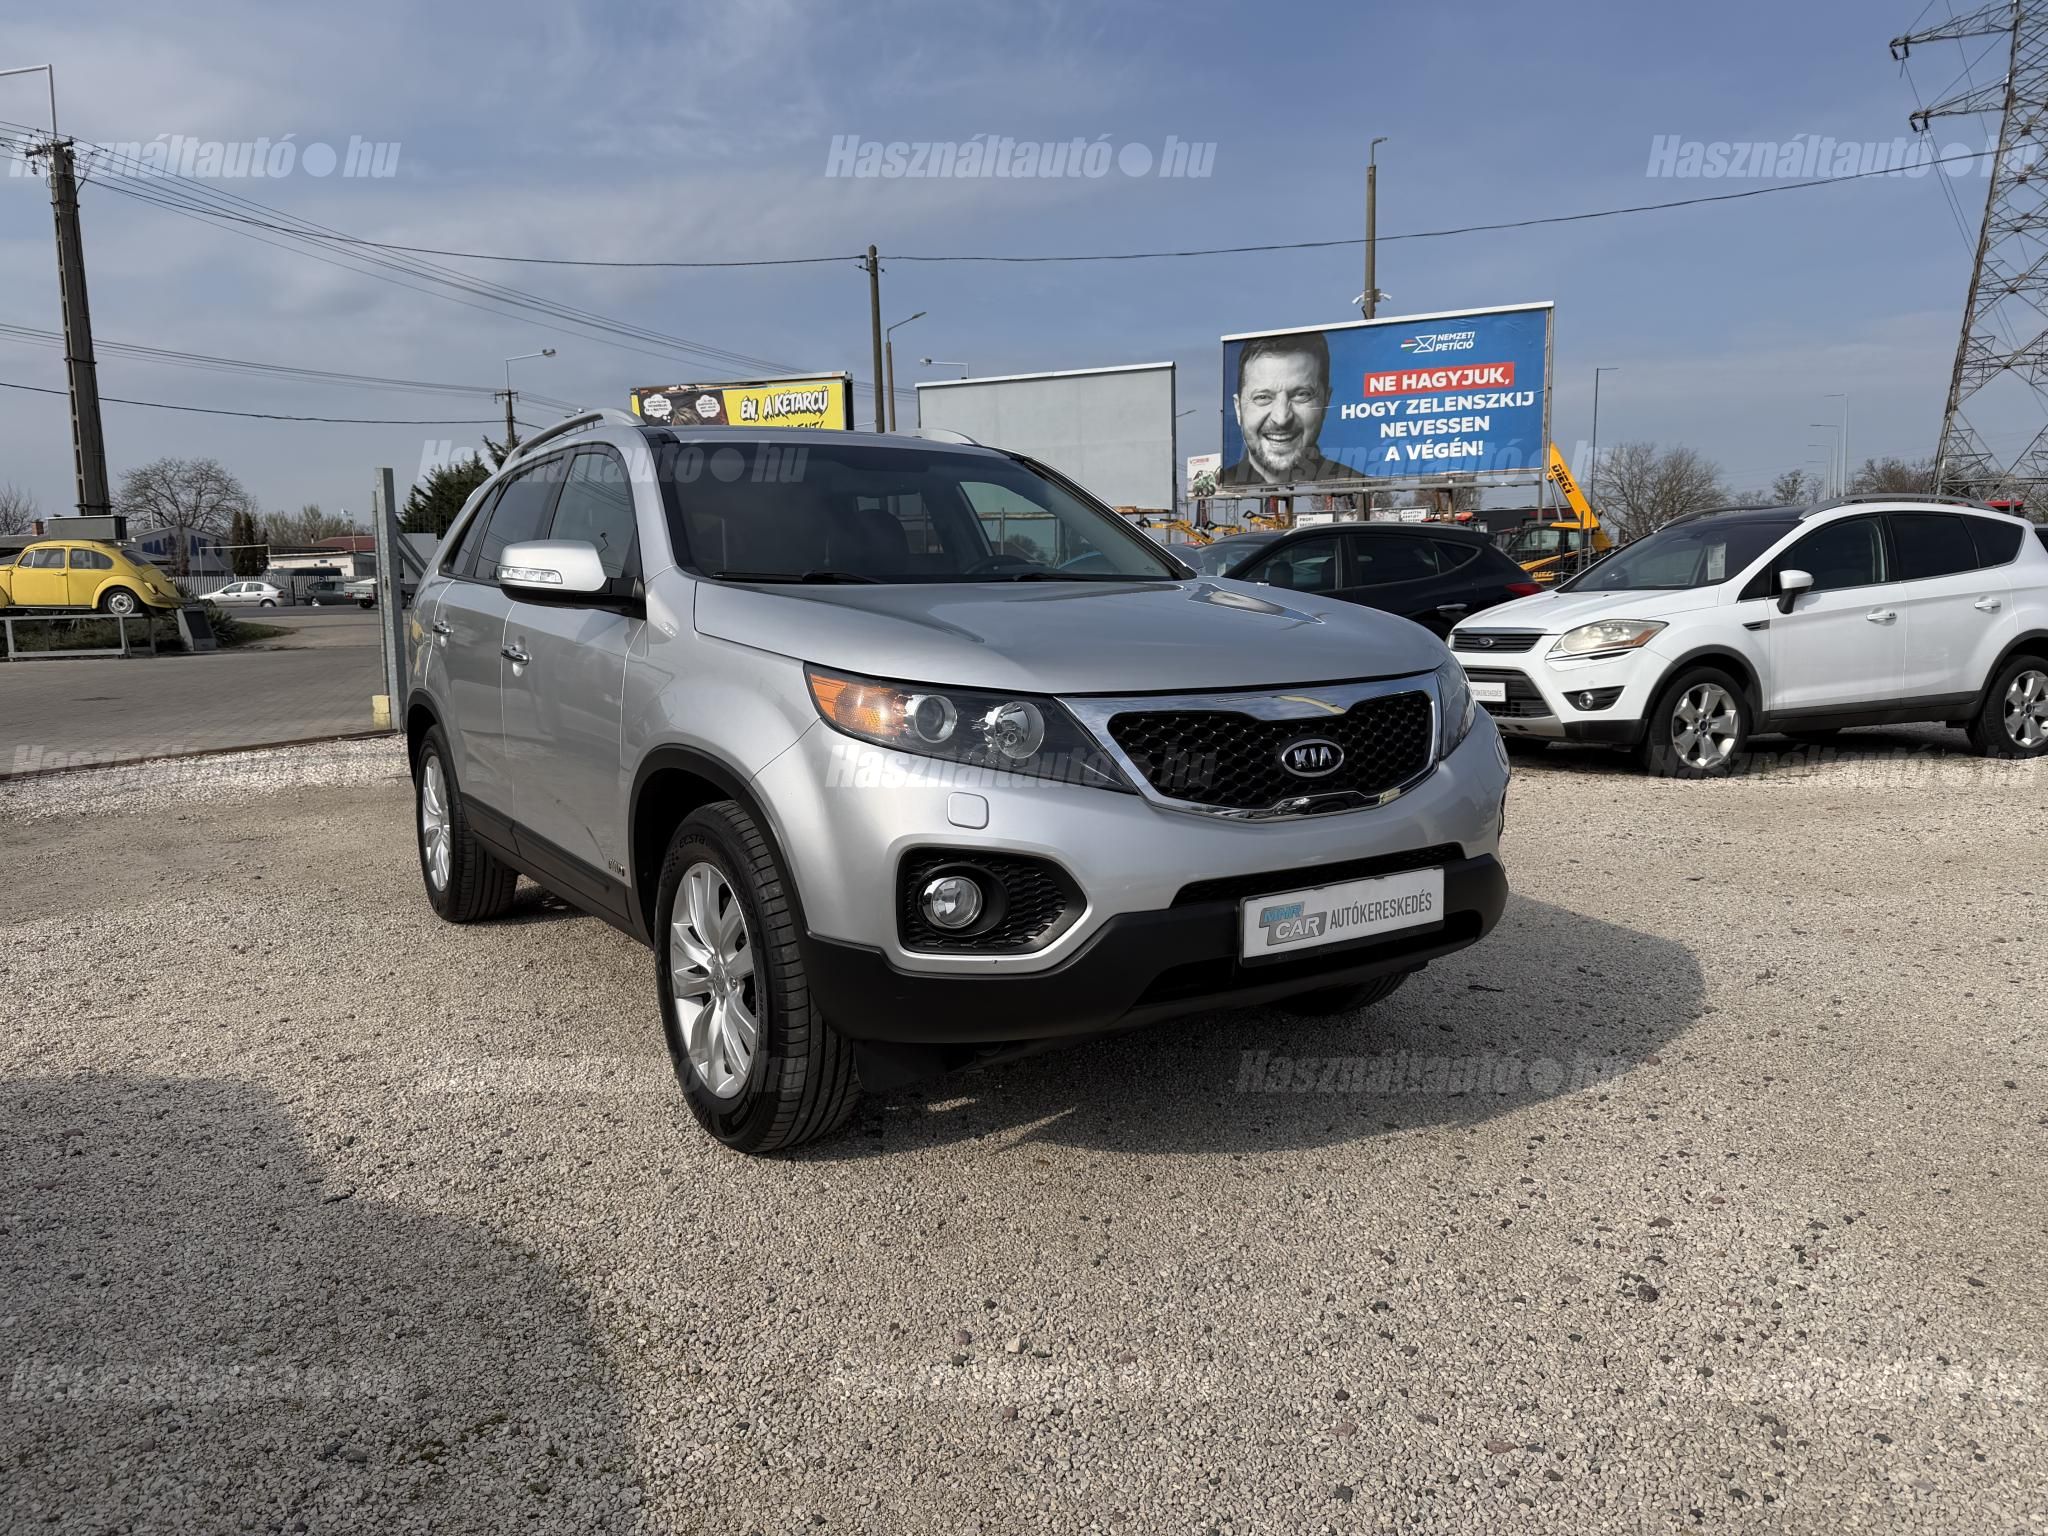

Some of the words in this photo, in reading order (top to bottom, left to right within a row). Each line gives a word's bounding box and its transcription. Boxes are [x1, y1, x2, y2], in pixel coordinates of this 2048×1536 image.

[1435, 340, 1474, 351] PETÍCIÓ
[1437, 331, 1475, 342] NEMZETI
[1369, 375, 1397, 393] NE
[1402, 367, 1511, 390] HAGYJUK,
[740, 395, 759, 422] ÉN,
[763, 395, 775, 421] A
[774, 386, 829, 418] KÉTARCÚ
[1341, 400, 1401, 420] HOGY
[1406, 391, 1535, 415] ZELENSZKIJ
[1380, 416, 1490, 438] NEVESSEN
[1384, 446, 1400, 462] A
[1406, 437, 1484, 460] VÉGÉN!
[1551, 463, 1575, 494] DIECI
[1294, 748, 1332, 769] KIA
[1276, 917, 1320, 939] CAR
[1330, 889, 1432, 929] AUTÓKERESKEDÉS
